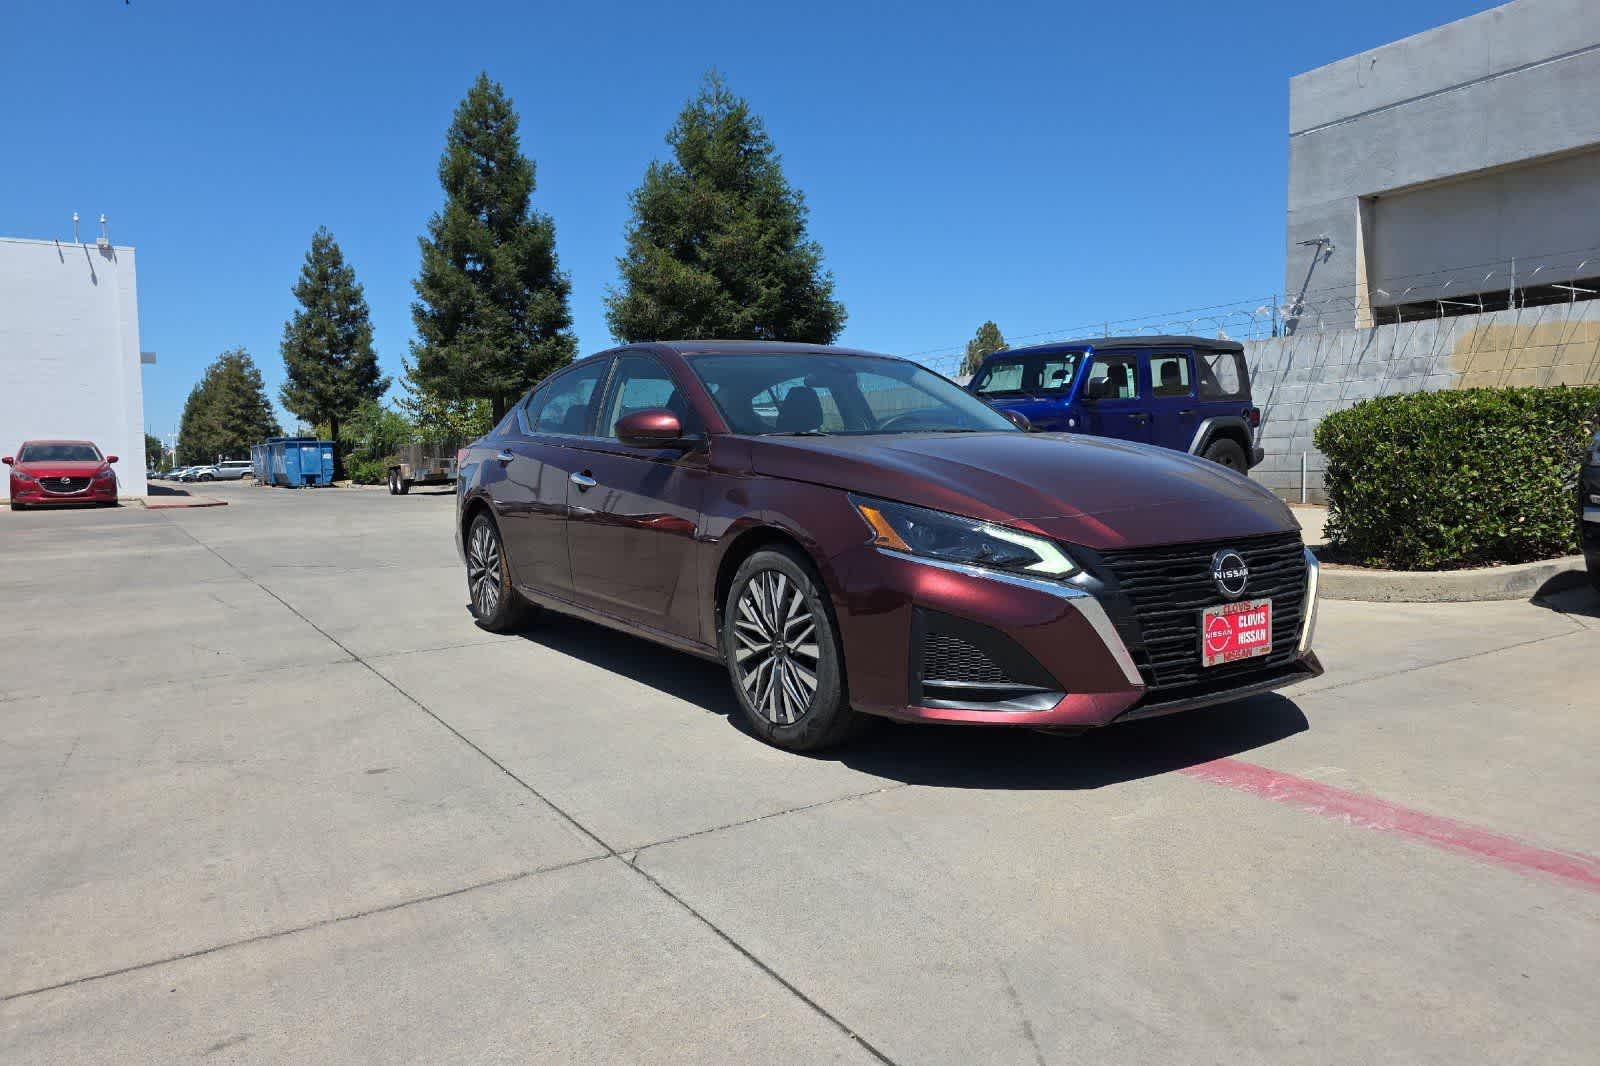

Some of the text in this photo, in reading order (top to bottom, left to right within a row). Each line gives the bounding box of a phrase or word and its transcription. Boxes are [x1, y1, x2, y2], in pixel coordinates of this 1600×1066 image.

[1214, 568, 1249, 579] NISSAN
[1238, 612, 1265, 628] CLOVIS
[1205, 629, 1232, 639] NISSAN
[1238, 629, 1266, 645] NISSAN
